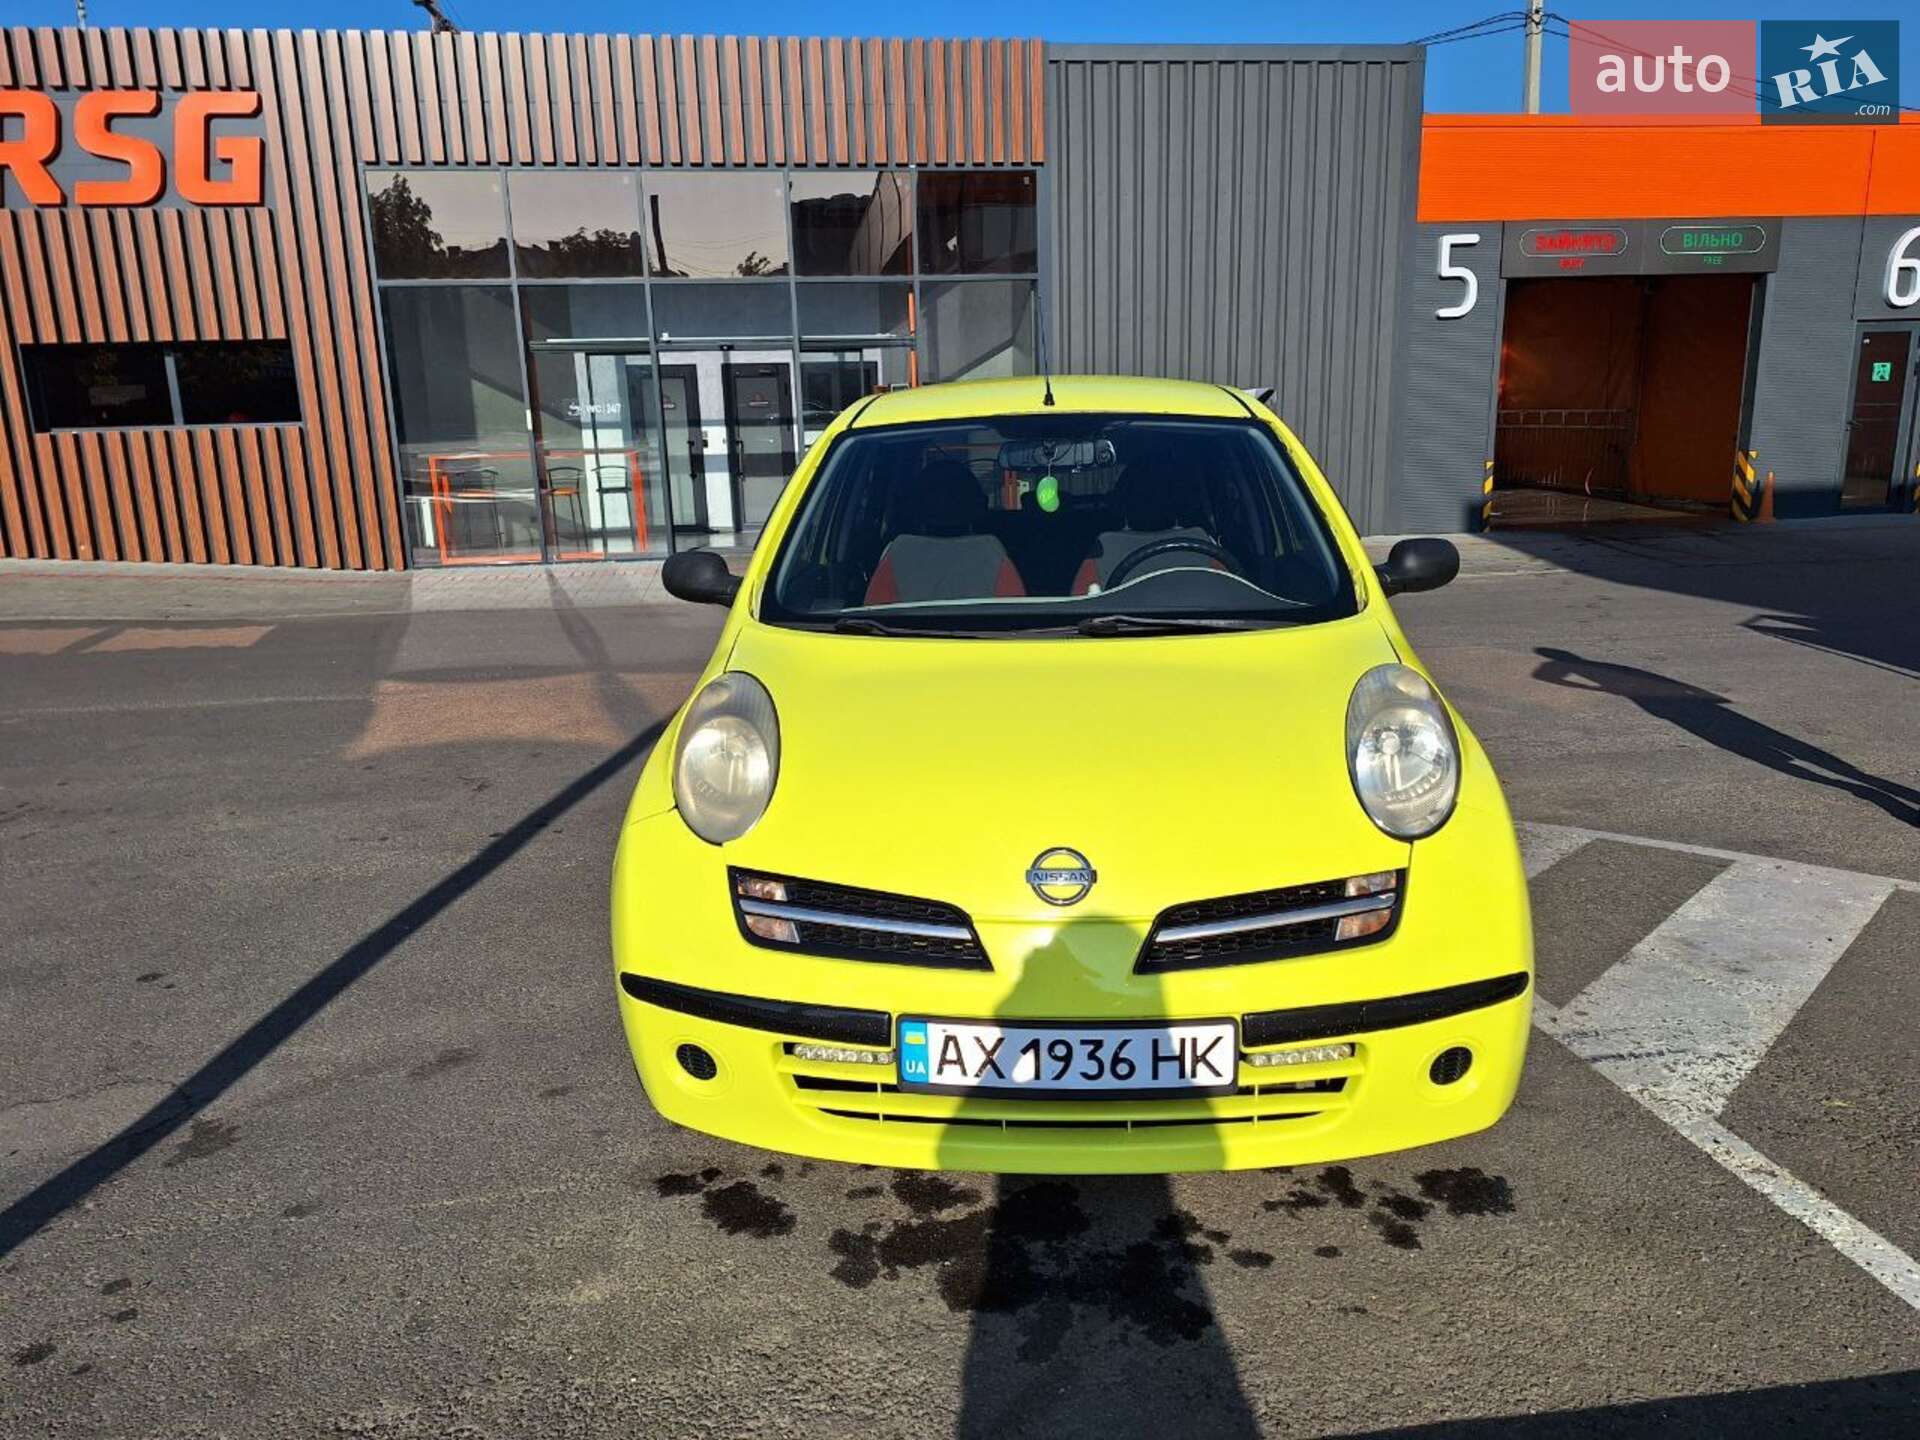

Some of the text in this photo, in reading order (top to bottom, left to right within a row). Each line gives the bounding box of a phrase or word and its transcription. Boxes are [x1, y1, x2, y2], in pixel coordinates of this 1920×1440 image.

[1682, 231, 1744, 250] ВІЛЬНО
[1435, 233, 1481, 320] 5
[1883, 226, 1920, 308] 6
[1032, 871, 1090, 882] NISSAN
[905, 1059, 926, 1075] UA
[935, 1032, 1225, 1082] AX 1936 HK
